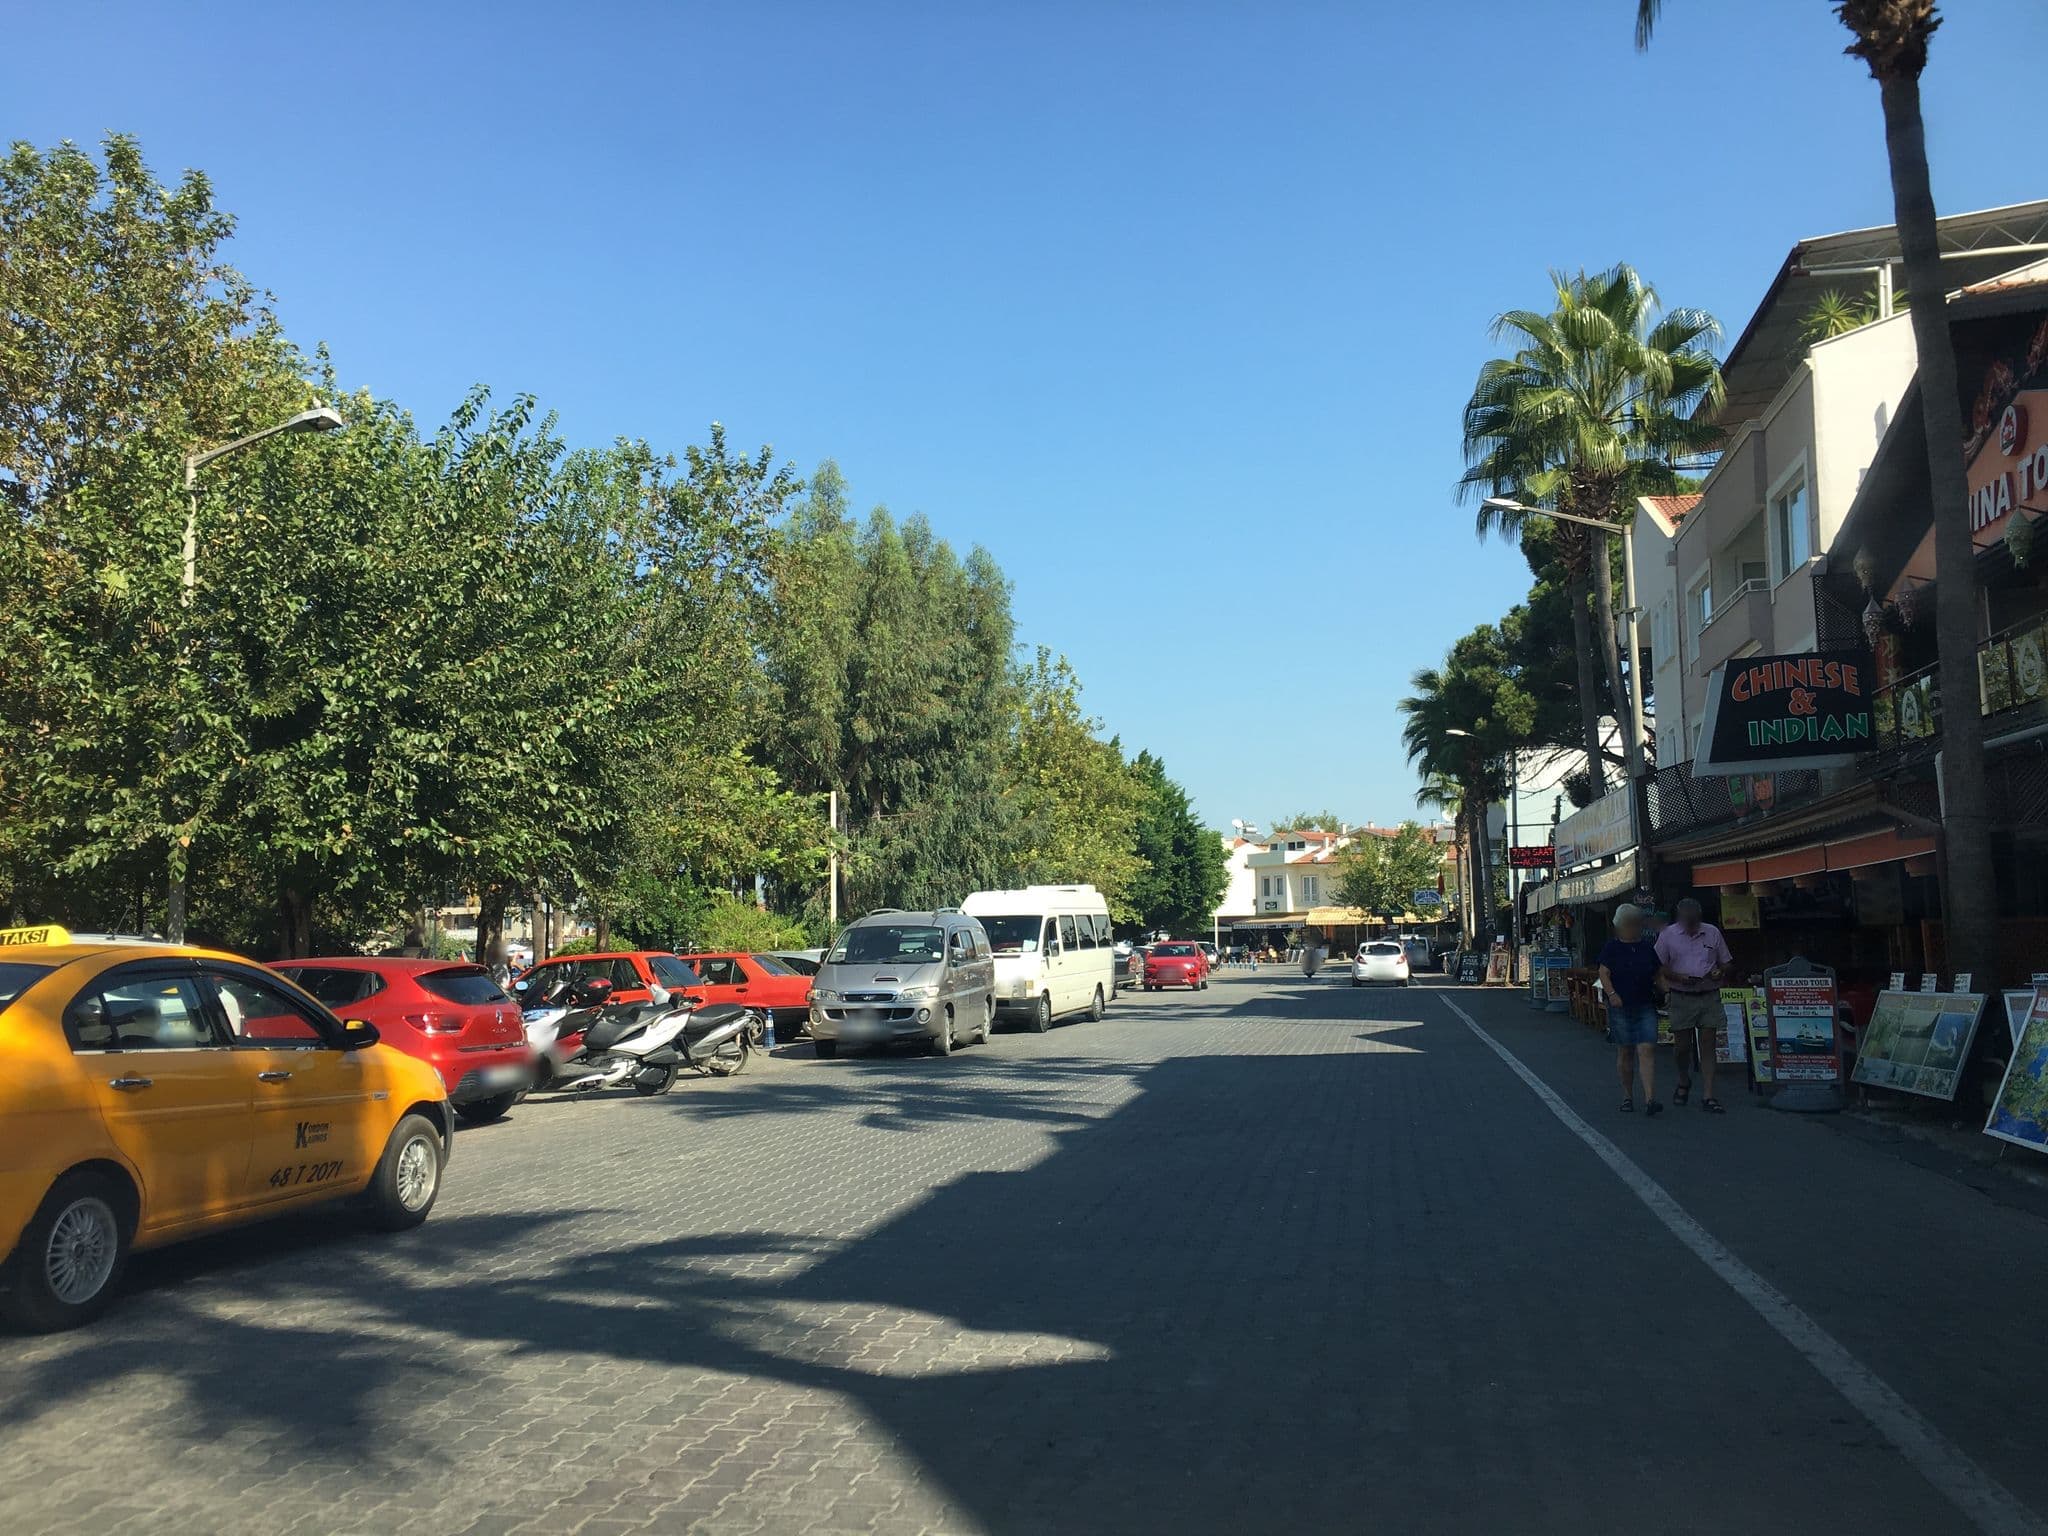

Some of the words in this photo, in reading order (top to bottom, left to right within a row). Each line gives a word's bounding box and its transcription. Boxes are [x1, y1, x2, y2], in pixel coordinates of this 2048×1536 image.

[1969, 472, 2011, 532] INA
[2017, 444, 2048, 501] TO
[1732, 659, 1861, 702] CHINESE
[1788, 687, 1818, 715] &
[1748, 713, 1869, 746] INDIAN
[1720, 991, 1744, 999] UNCH
[1784, 979, 1809, 987] ISLAND
[1810, 979, 1830, 987] TOUR
[270, 1168, 293, 1186] 48
[295, 1165, 307, 1184] T
[306, 1160, 343, 1183] 2071
